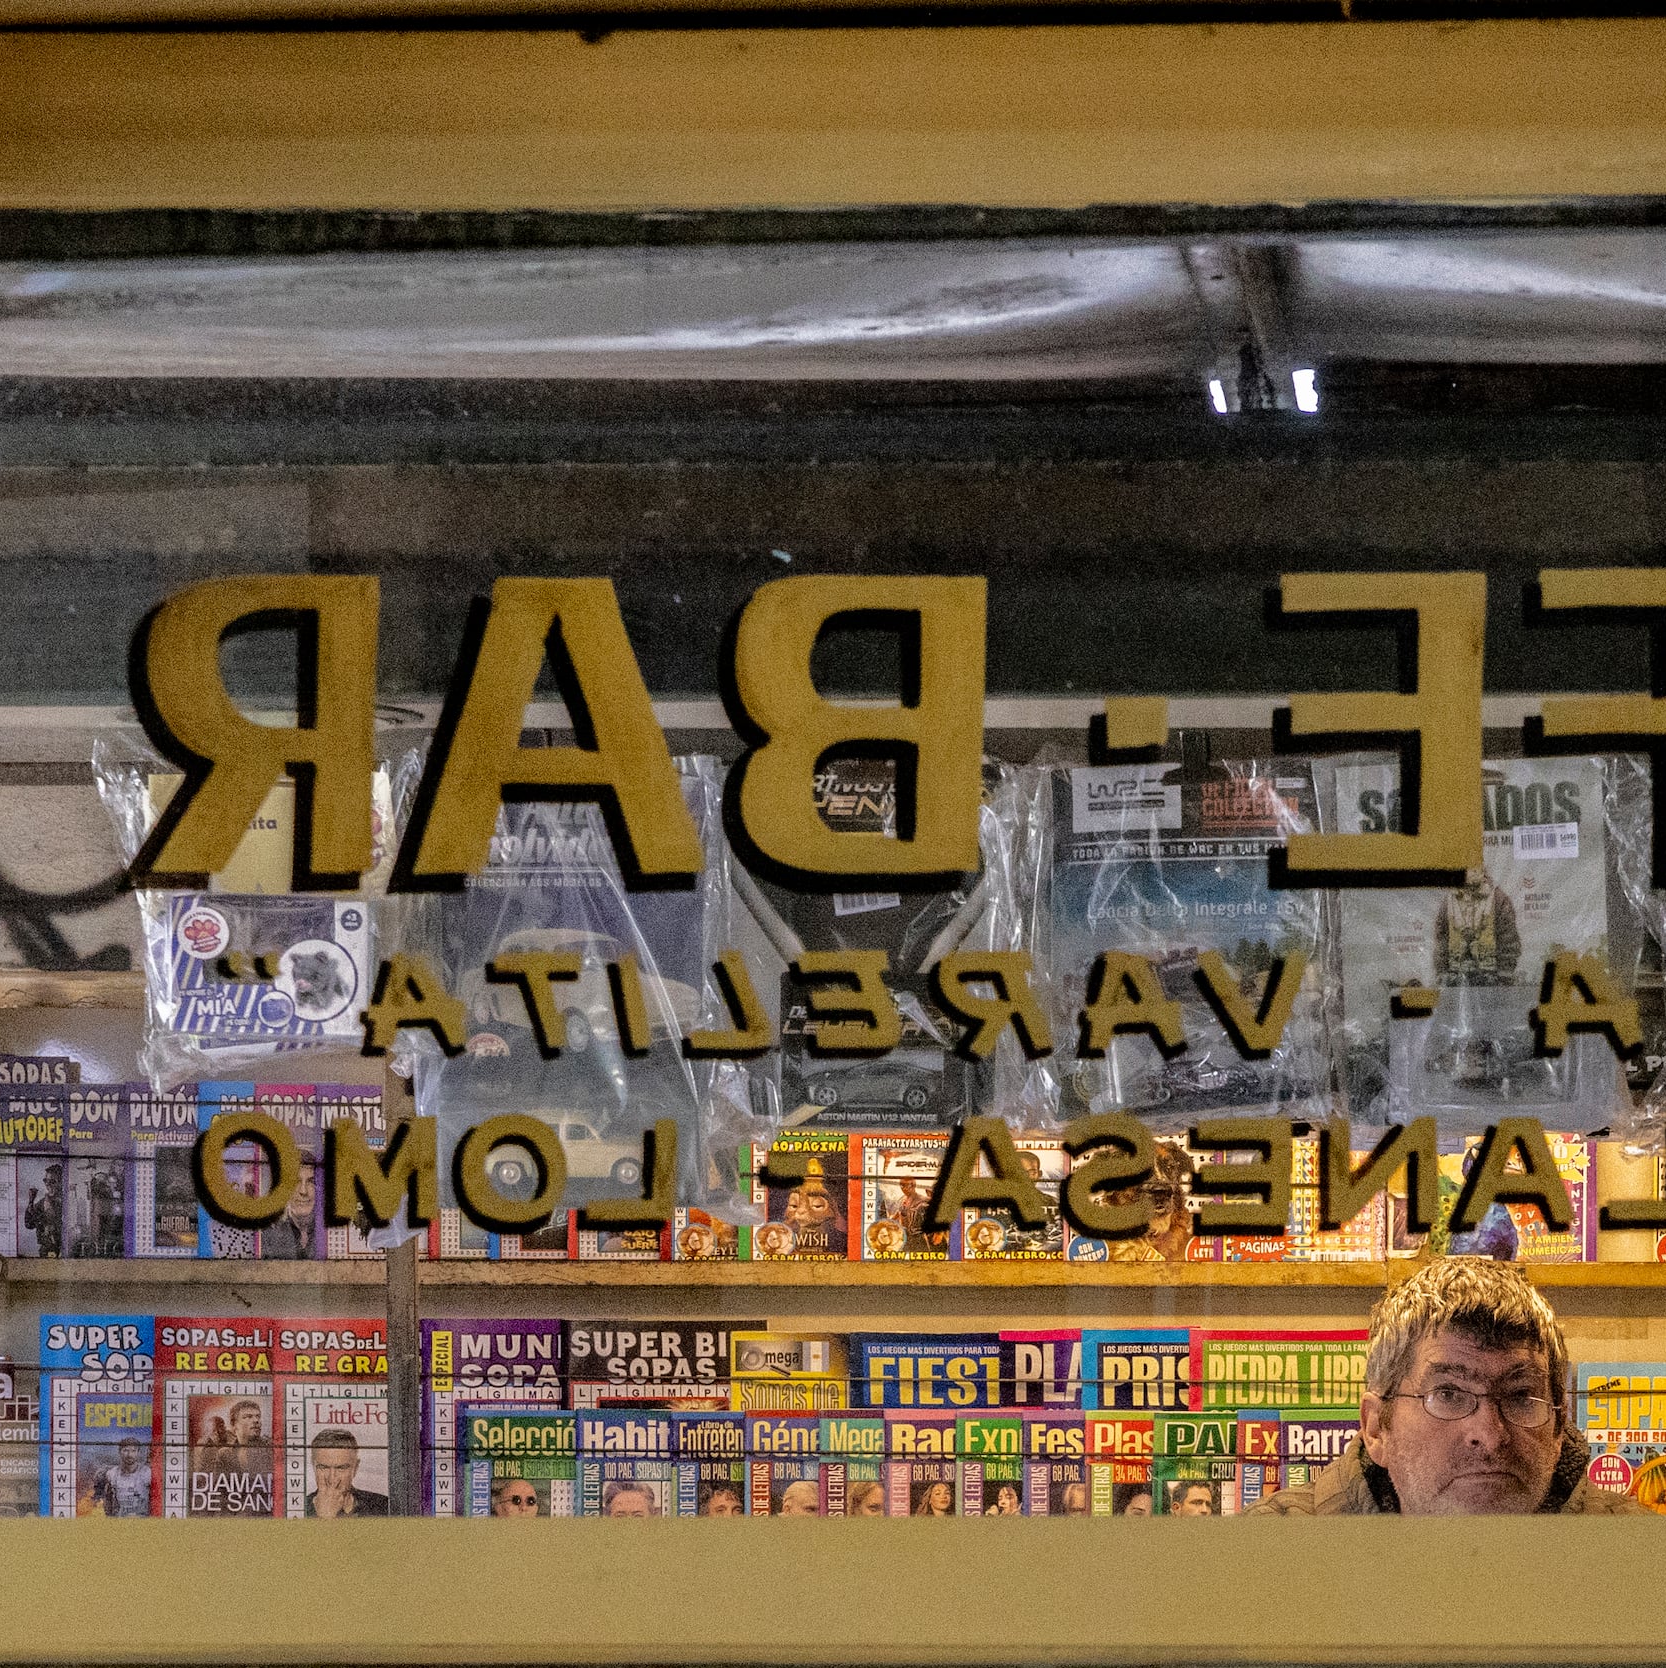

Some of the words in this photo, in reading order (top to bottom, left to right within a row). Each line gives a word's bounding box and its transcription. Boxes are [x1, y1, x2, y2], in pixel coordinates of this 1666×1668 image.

[69, 1091, 120, 1125] DON
[795, 1234, 828, 1246] WISH
[1239, 1239, 1287, 1255] PÁGINAS
[874, 1252, 907, 1260] GRAN
[910, 1252, 945, 1260] LIBRO
[46, 1324, 140, 1351] SUPER
[570, 1331, 682, 1358] SUPER
[175, 1352, 209, 1371] RE
[296, 1355, 329, 1373] RE
[435, 1335, 449, 1388] ESPECIAL
[607, 1358, 717, 1384] SOPAS
[1209, 1355, 1299, 1405] PIEDRA
[1608, 1433, 1622, 1443] DE
[1625, 1432, 1649, 1443] 300
[1601, 1456, 1620, 1468] CON
